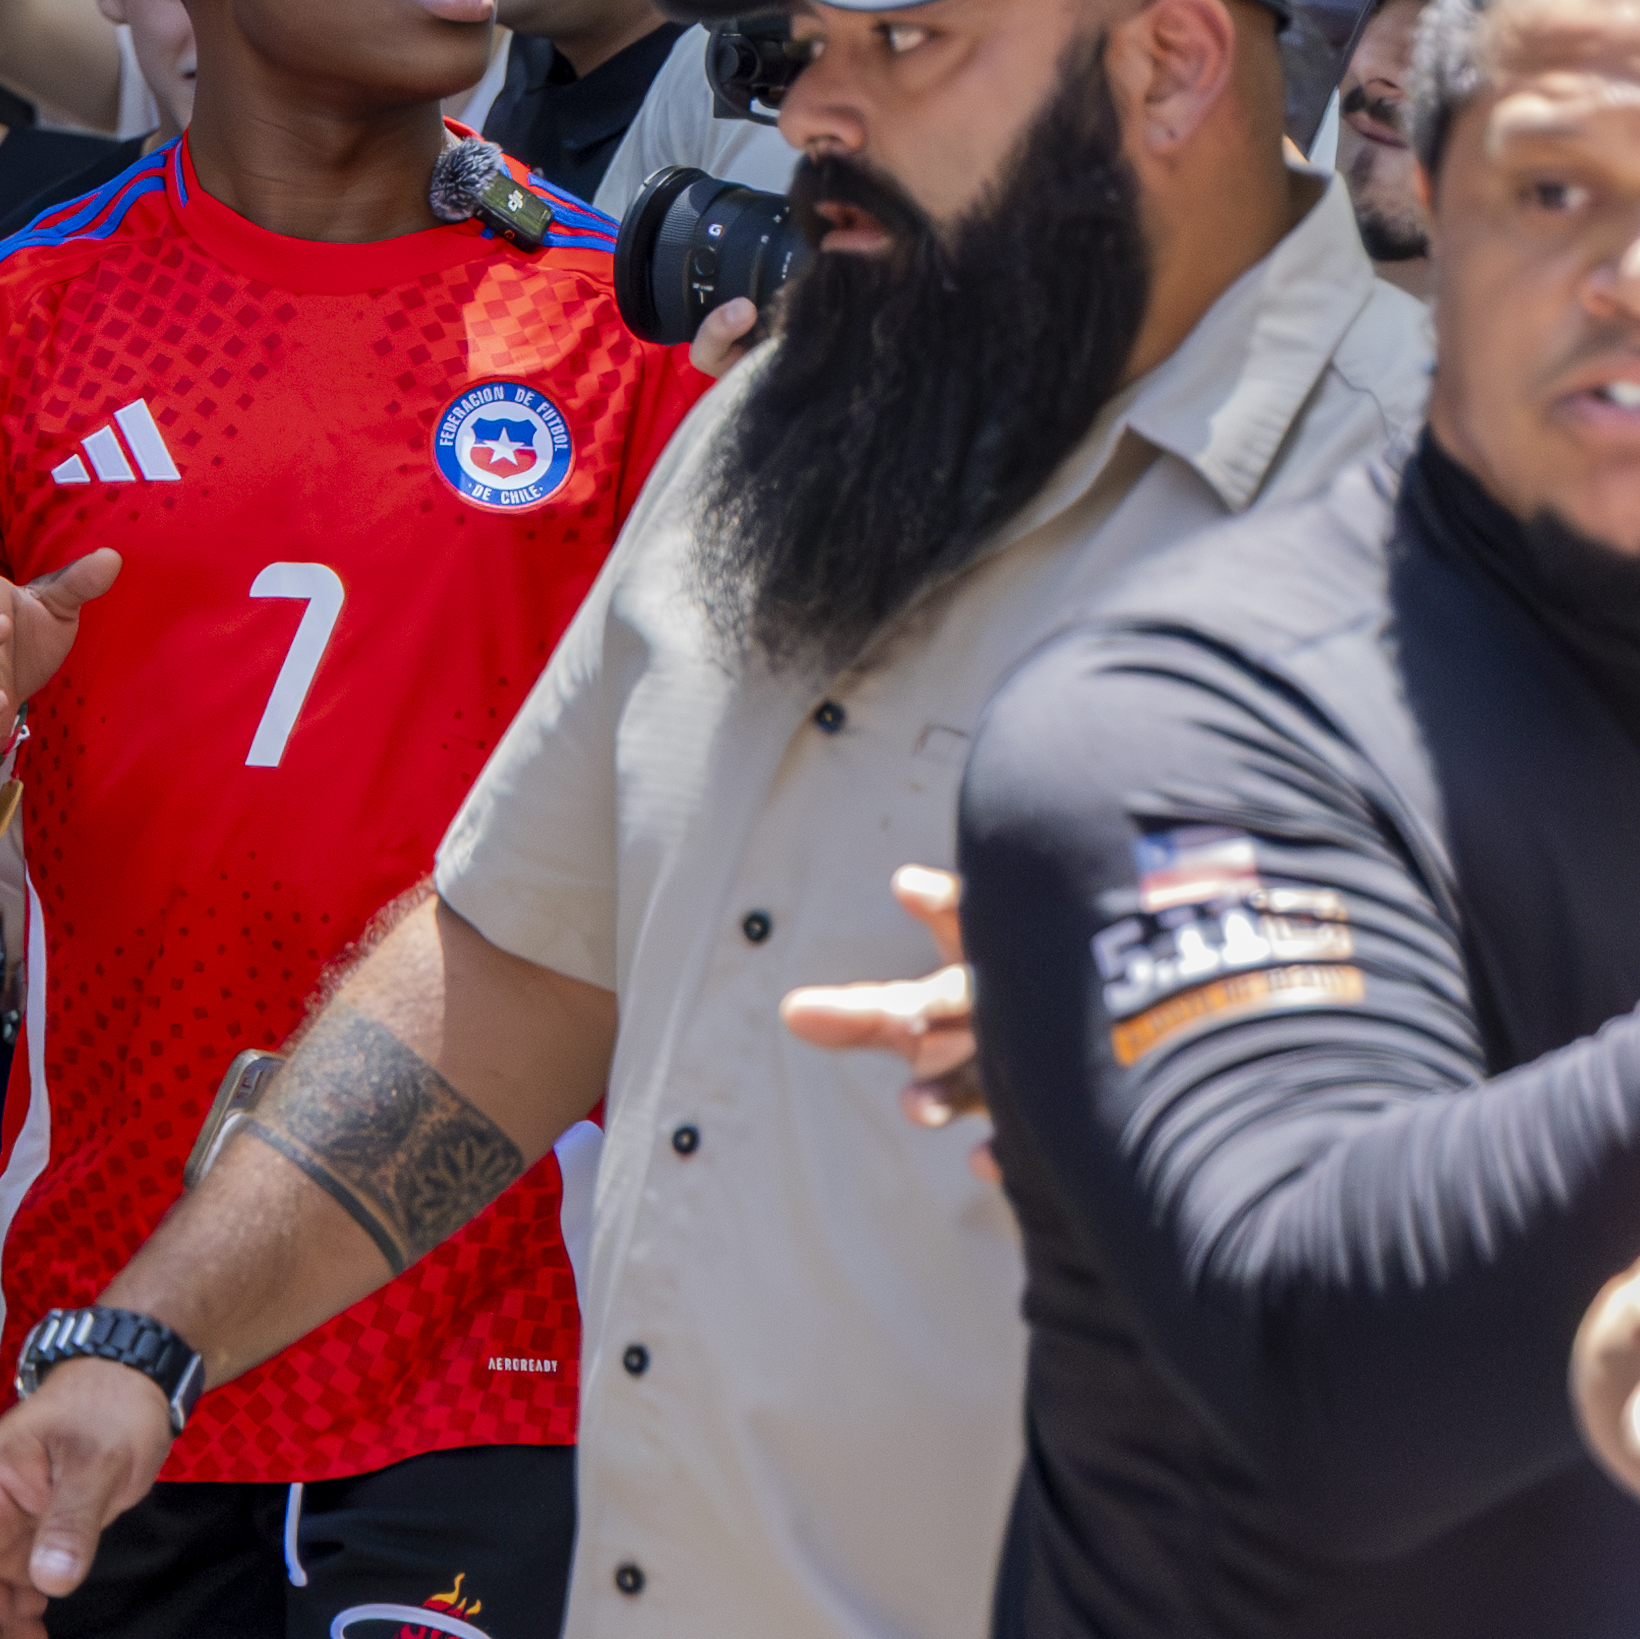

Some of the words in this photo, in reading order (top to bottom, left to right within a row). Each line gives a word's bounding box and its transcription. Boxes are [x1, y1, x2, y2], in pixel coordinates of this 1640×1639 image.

[439, 385, 506, 447] FEDERACION
[514, 387, 536, 407] DE
[535, 401, 569, 452] FUTBOL
[471, 485, 493, 502] DE
[500, 484, 542, 505] CHILE
[244, 561, 346, 768] 7
[487, 1356, 559, 1373] AEROREADY
